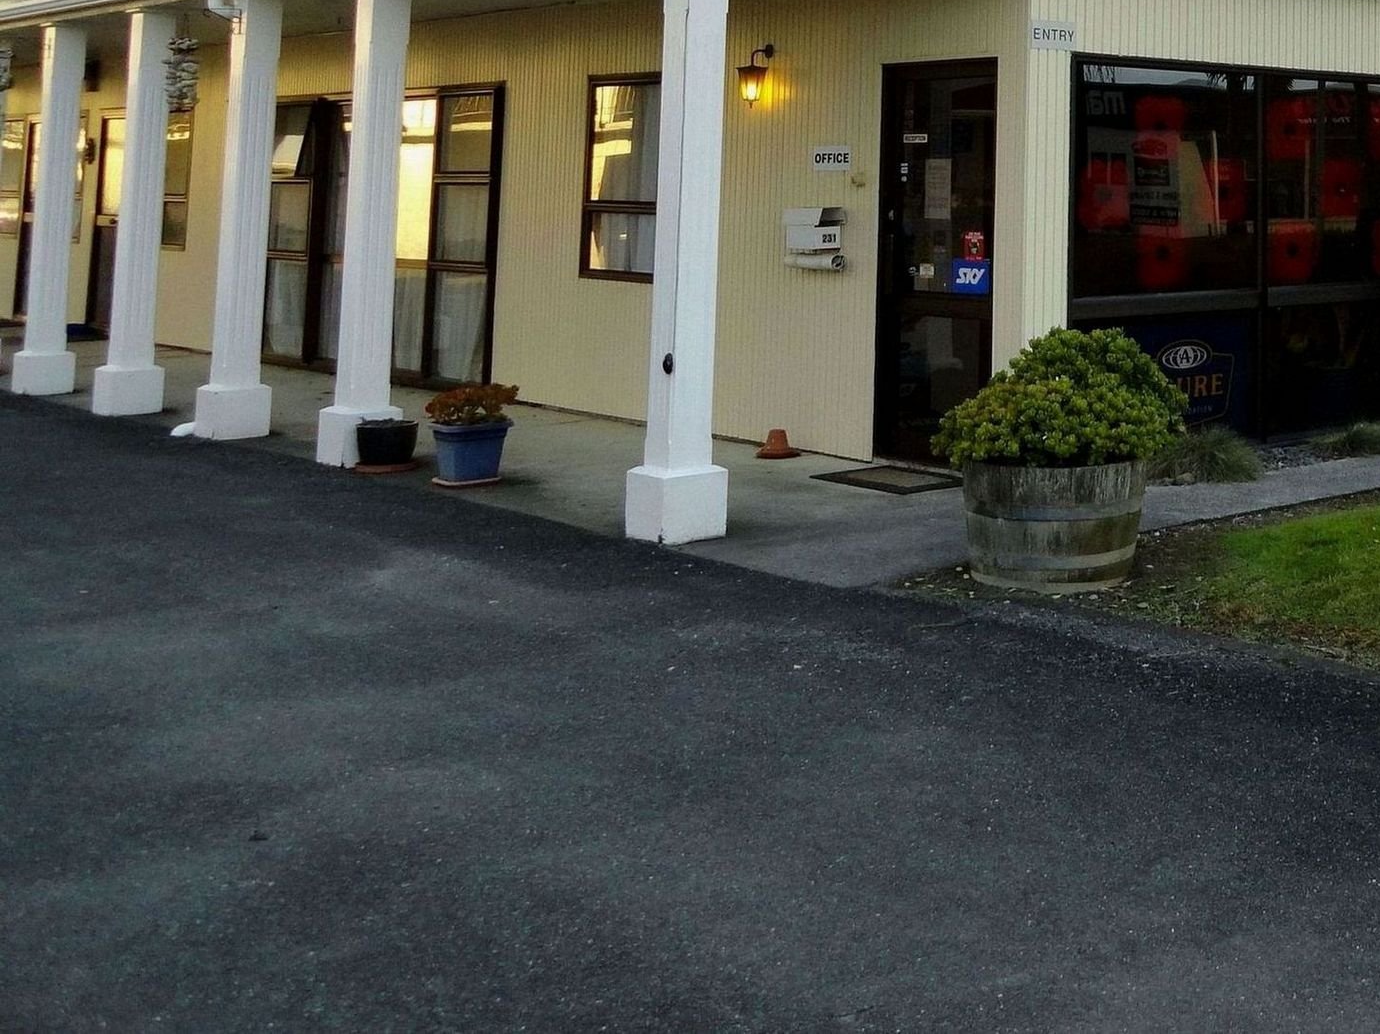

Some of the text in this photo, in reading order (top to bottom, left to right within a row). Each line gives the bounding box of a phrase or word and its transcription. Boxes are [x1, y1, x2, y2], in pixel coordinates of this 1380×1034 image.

[1032, 27, 1075, 42] ENTRY
[814, 151, 849, 165] OFFICE
[821, 232, 836, 244] 231
[955, 267, 985, 284] SKY
[1176, 372, 1225, 398] URE
